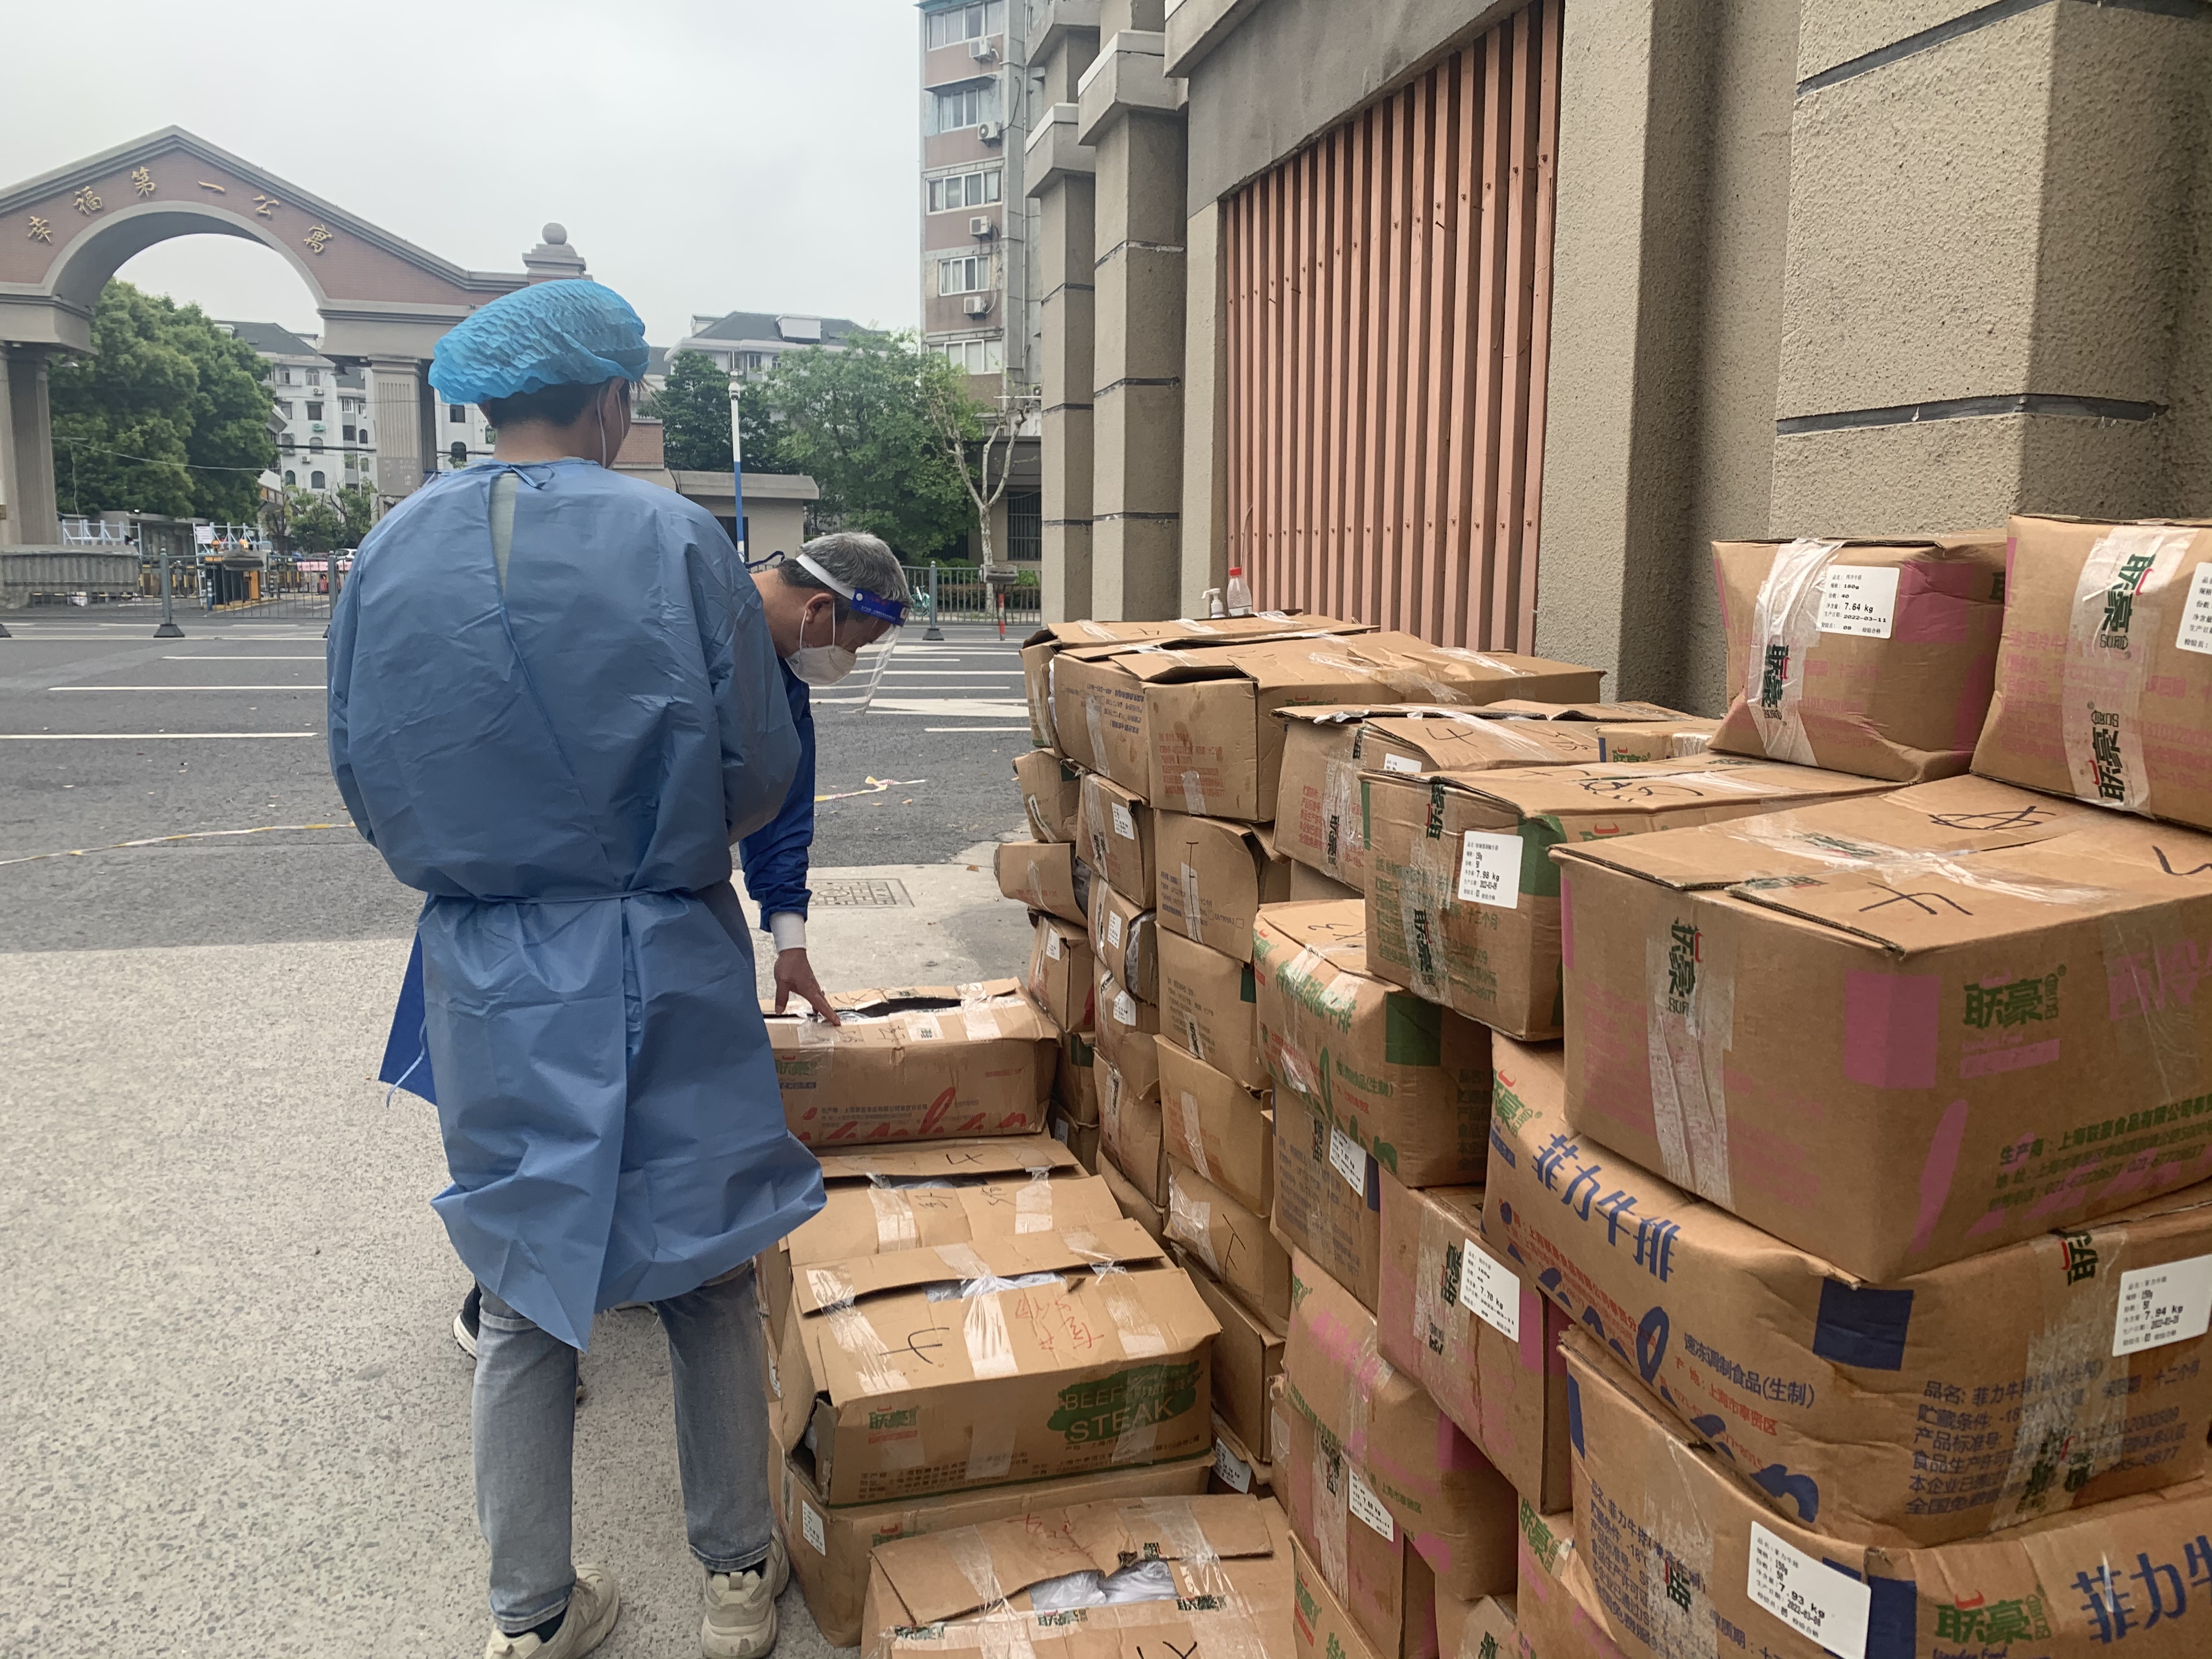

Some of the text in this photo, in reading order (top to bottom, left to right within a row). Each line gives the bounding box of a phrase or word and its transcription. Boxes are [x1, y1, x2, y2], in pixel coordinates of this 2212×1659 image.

[27, 166, 334, 253] 幸福第一公寓
[1843, 614, 1886, 623] 2022-03-11
[1844, 602, 1861, 611] 7.64
[1865, 605, 1874, 613] kg
[1476, 870, 1489, 879] 7.98
[1493, 872, 1499, 882] kg
[1531, 1132, 1681, 1283] 菲力牛排
[1480, 1286, 1493, 1302] 7.70
[1496, 1297, 1503, 1310] kg
[2172, 1305, 2183, 1313] kg
[1064, 1385, 1123, 1410] BEEF
[1070, 1396, 1173, 1442] STEAK
[1779, 1583, 1804, 1605] 7.93
[1811, 1602, 1825, 1618] kg
[1934, 1599, 2033, 1645] 联豪
